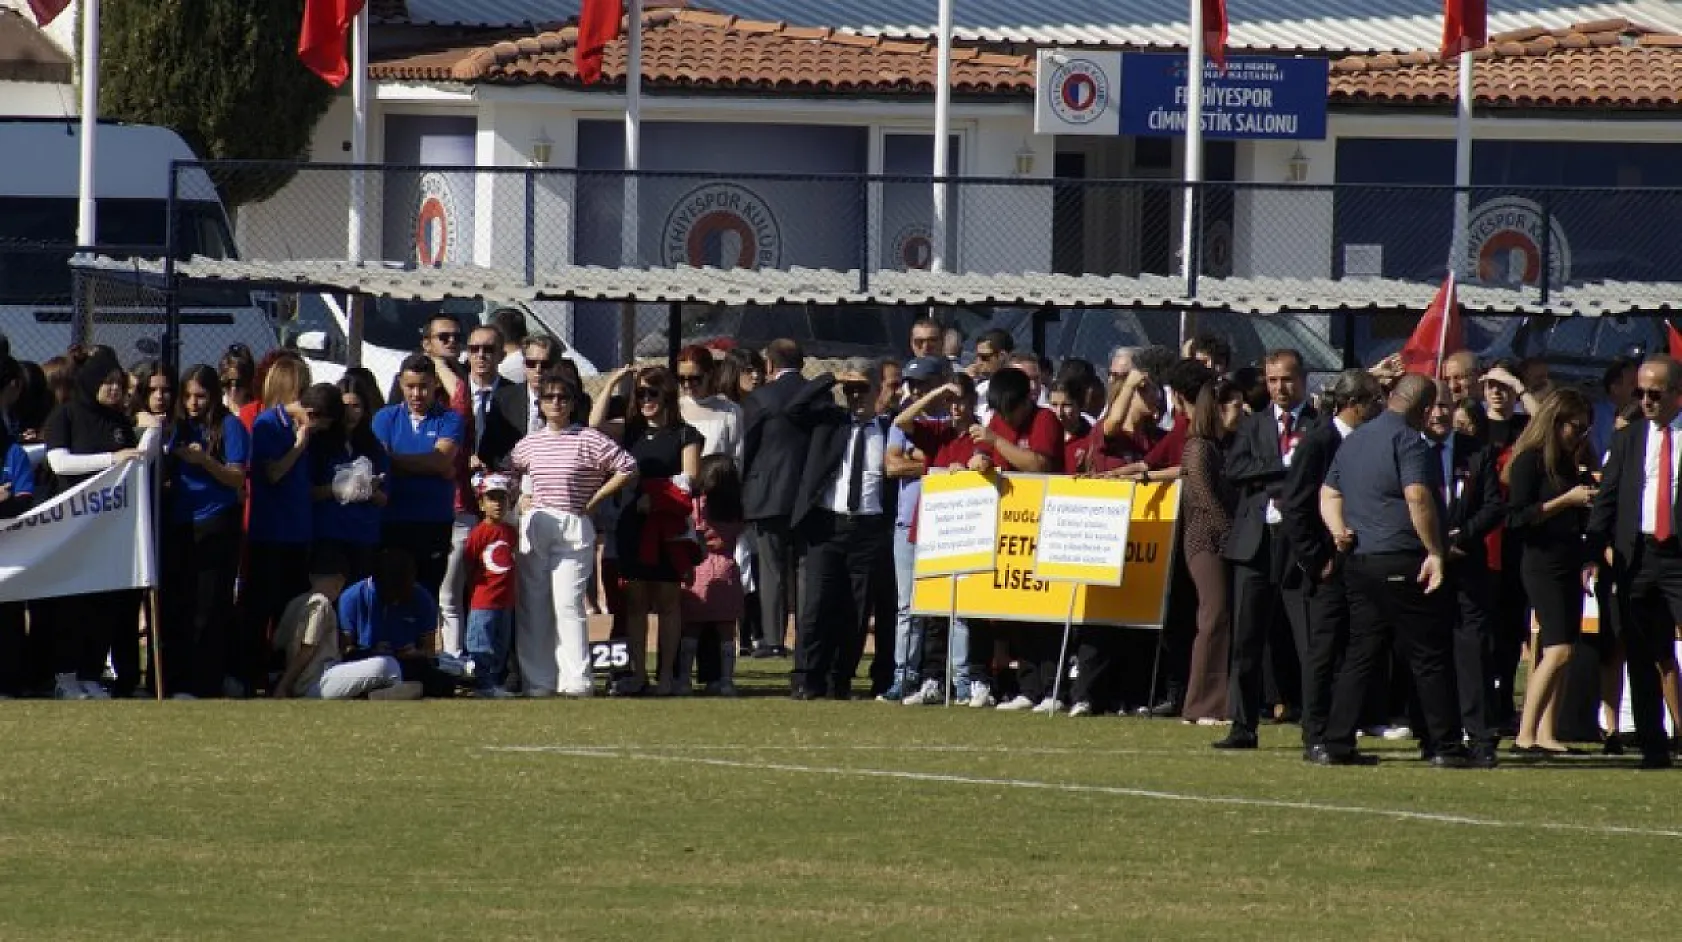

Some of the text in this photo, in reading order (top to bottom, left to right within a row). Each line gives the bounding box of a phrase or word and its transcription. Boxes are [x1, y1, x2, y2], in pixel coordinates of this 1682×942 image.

[1235, 112, 1299, 133] SALONU
[1003, 508, 1039, 523] MUĞL
[592, 644, 630, 667] 25
